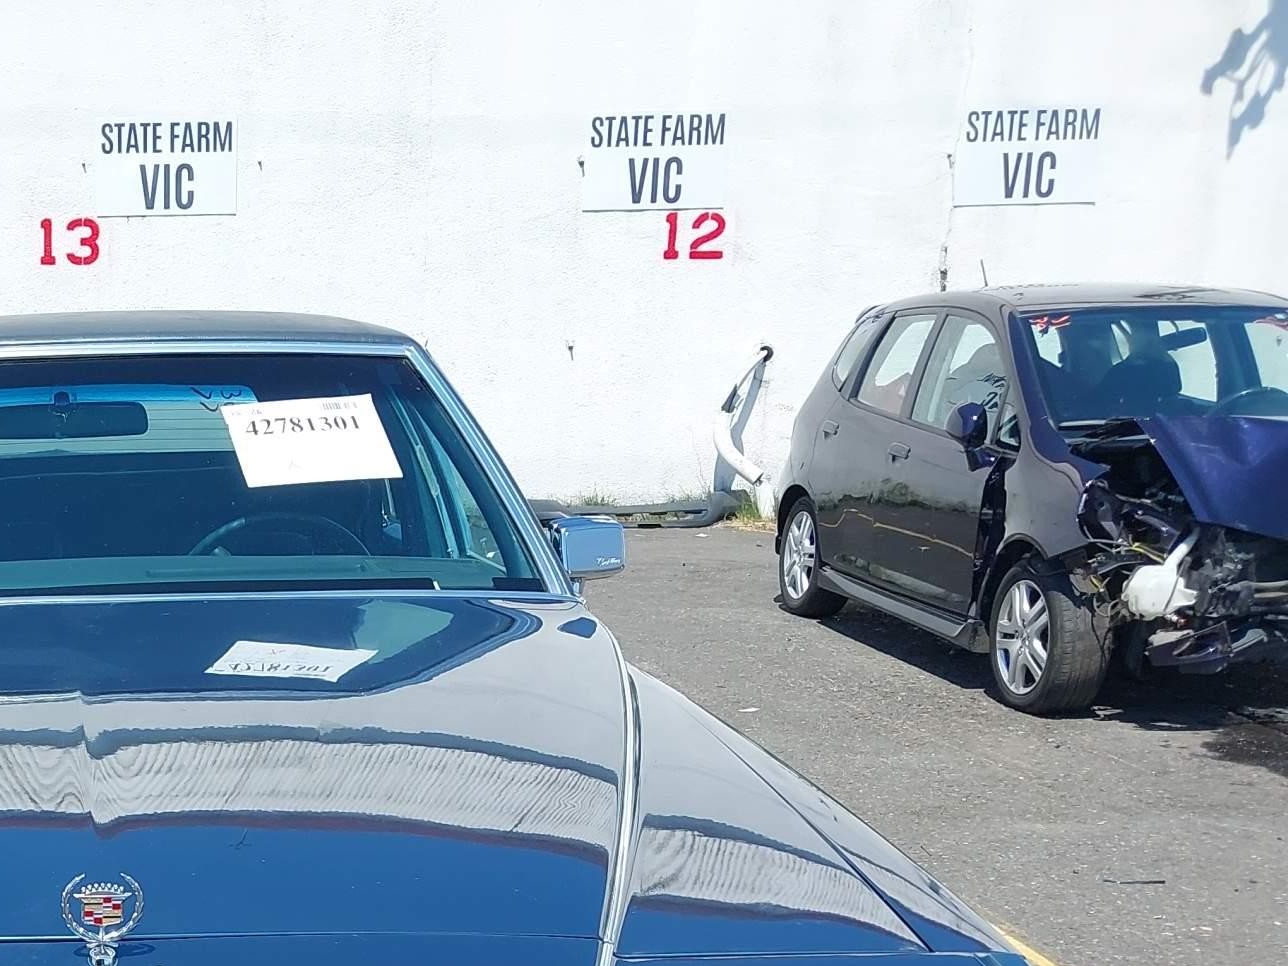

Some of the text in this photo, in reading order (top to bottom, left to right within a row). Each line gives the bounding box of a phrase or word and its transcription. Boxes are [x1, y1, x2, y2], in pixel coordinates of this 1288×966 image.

[101, 121, 233, 154] STATE FARM
[591, 114, 725, 148] STATE FARM
[966, 108, 1100, 142] STATE FARM
[140, 163, 195, 210] VIC
[629, 157, 684, 204] VIC
[1002, 151, 1057, 199] VIC
[40, 217, 100, 265] 13
[663, 211, 726, 260] 12
[245, 415, 360, 436] 42781301
